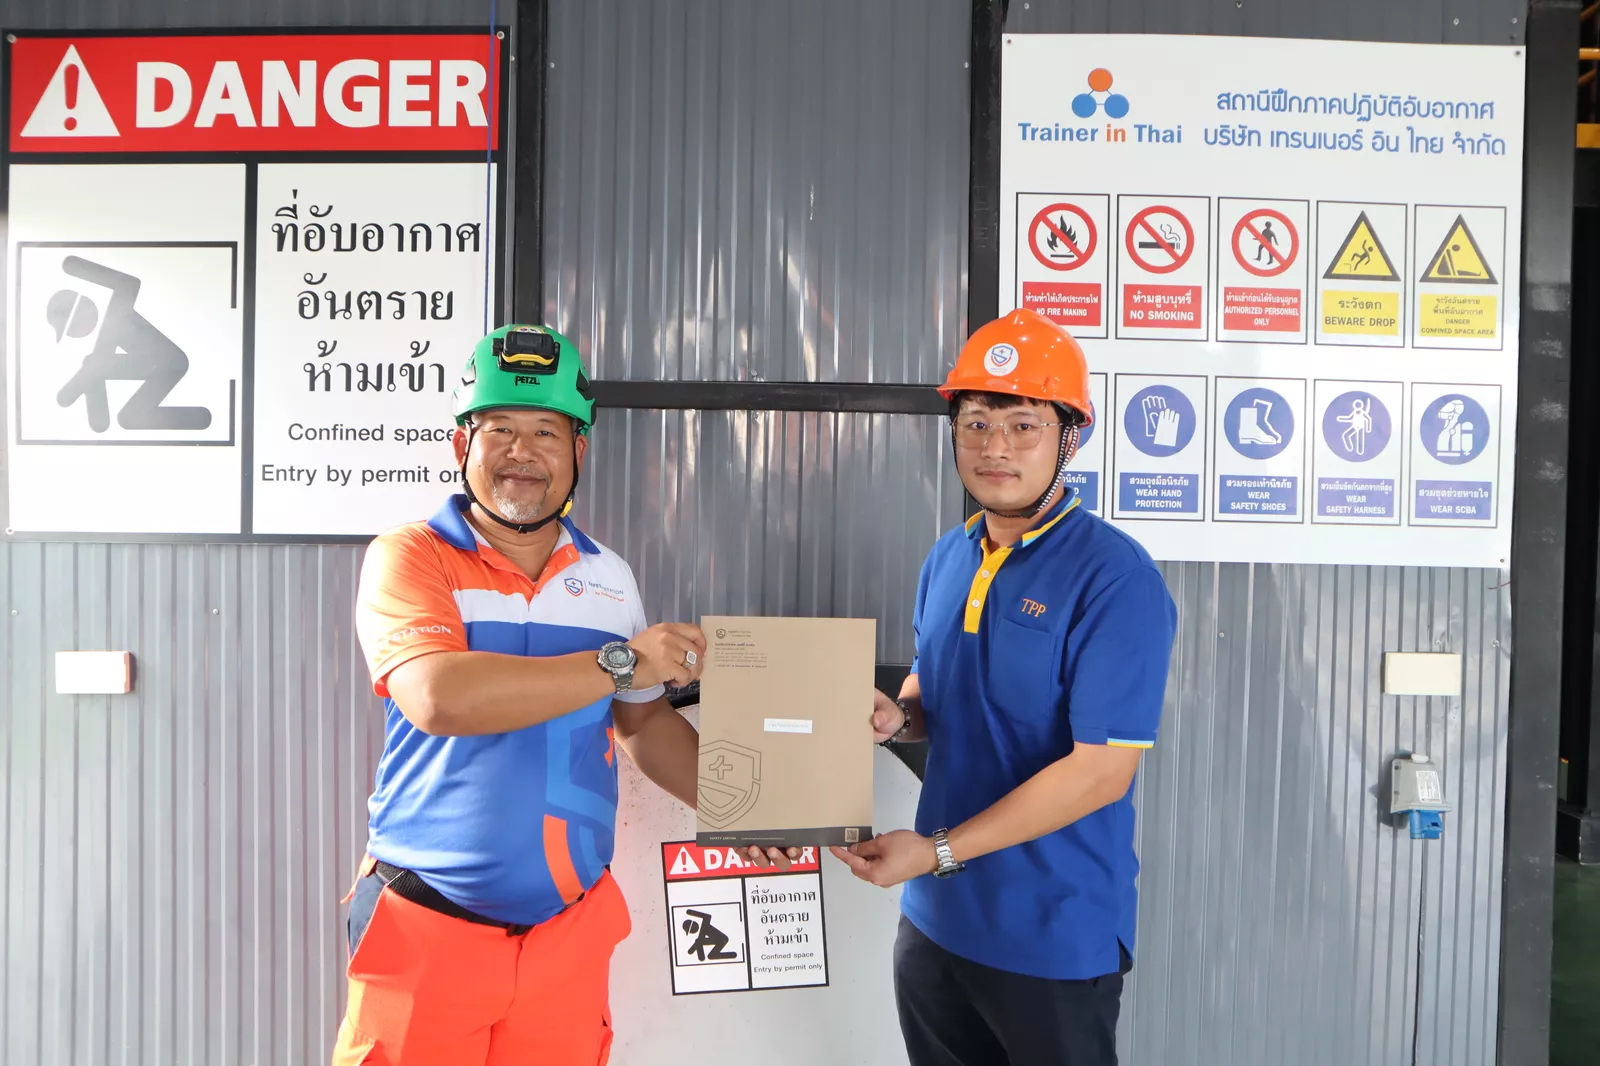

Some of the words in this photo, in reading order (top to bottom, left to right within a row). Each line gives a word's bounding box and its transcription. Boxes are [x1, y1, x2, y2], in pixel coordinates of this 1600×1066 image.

[135, 60, 488, 128] DANGER
[1017, 123, 1098, 141] Trainer
[1106, 124, 1126, 142] in
[1134, 124, 1182, 143] Thai
[1204, 124, 1261, 146] บริษัท
[1270, 129, 1363, 151] เทรนเนอร์
[1372, 131, 1399, 152] อิน
[1406, 125, 1443, 154] ไทย
[1452, 131, 1505, 155] จำกัด
[271, 189, 481, 253] ที่อับอากาศ
[297, 273, 454, 320] อันตราย
[1132, 289, 1192, 308] ห้ามสูบบุหรี่
[1338, 296, 1382, 310] ระวังตก
[1063, 308, 1087, 316] MAKING
[1130, 310, 1144, 319] NO
[1148, 311, 1194, 321] SMOKING
[1225, 306, 1263, 314] AUTHORIZED
[1264, 307, 1299, 316] PERSONNEL
[1254, 318, 1270, 326] ONLY
[1325, 316, 1365, 326] BEWARE
[1369, 318, 1395, 327] DROP
[303, 340, 446, 393] ห้ามเข้า
[515, 375, 540, 386] PETZL
[288, 423, 384, 441] Confined
[394, 428, 454, 445] space
[261, 464, 317, 486] Entry
[327, 465, 352, 486] by
[362, 466, 430, 486] permit
[439, 470, 464, 483] on
[1161, 489, 1182, 497] HAND
[1248, 491, 1270, 499] WEAR
[1346, 495, 1366, 503] WEAR
[1135, 500, 1182, 508] PROTECTION
[1231, 502, 1259, 510] SAFETY
[1261, 503, 1286, 511] SHOES
[1354, 506, 1386, 515] HARNESS
[1430, 505, 1452, 513] WEAR
[1455, 505, 1476, 514] SCBA
[1021, 598, 1046, 617] TPP
[392, 625, 451, 640] STATION
[703, 846, 815, 871] DAR
[751, 885, 816, 904] ที่อับอากาศ
[760, 909, 809, 924] อันตราย
[764, 927, 809, 945] ห้ามเข้า
